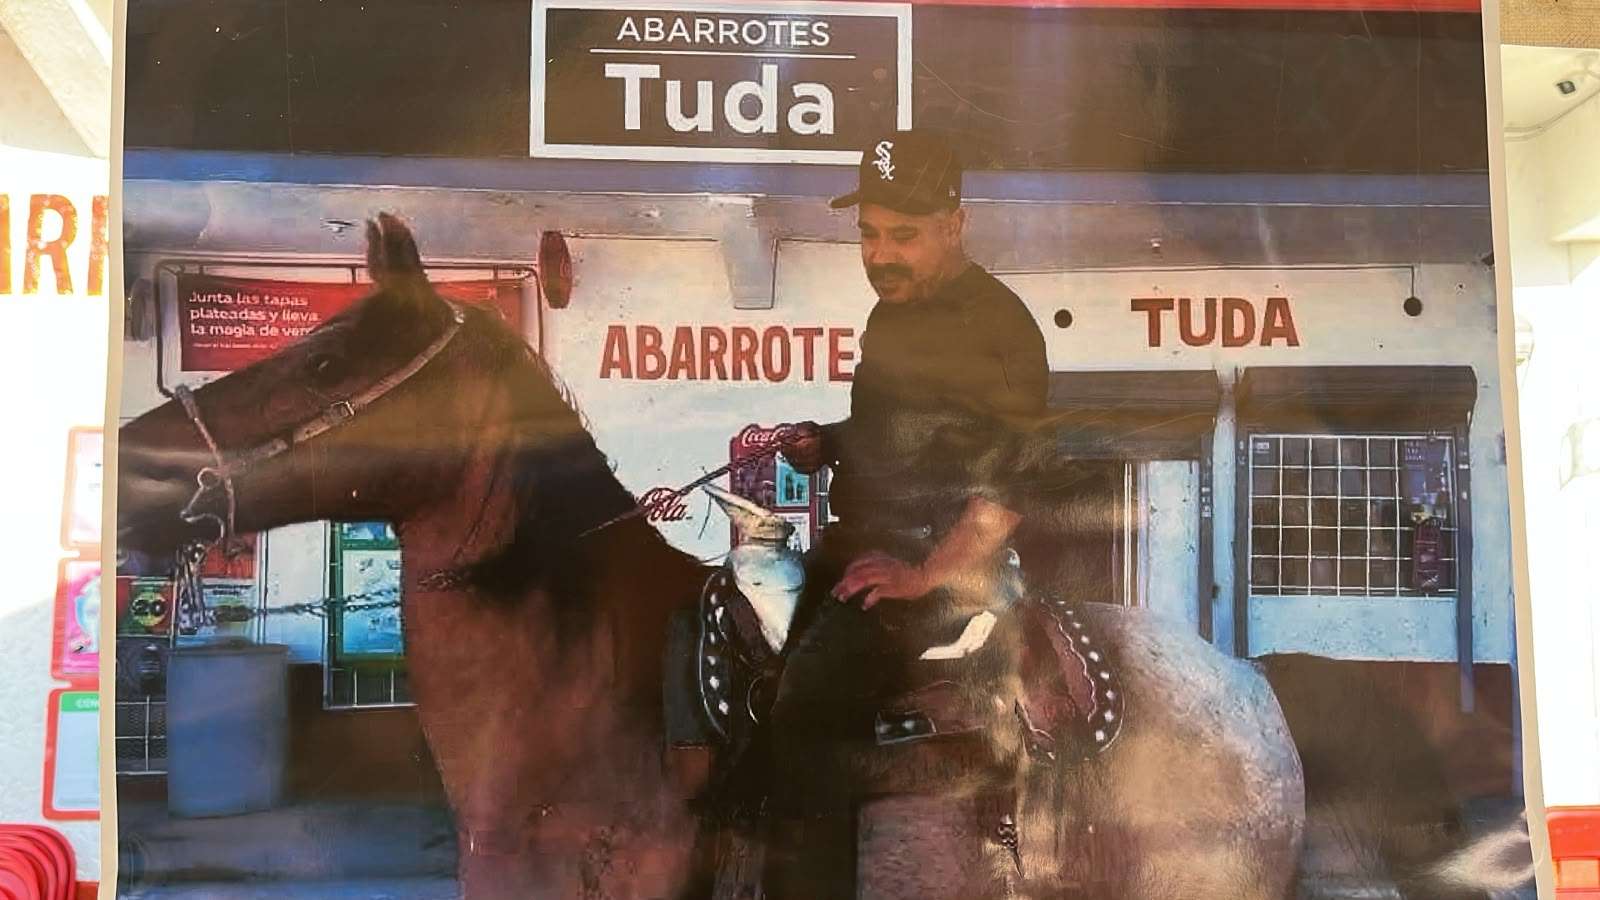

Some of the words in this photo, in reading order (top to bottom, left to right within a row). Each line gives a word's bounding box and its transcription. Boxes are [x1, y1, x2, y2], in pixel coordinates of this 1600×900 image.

[617, 17, 830, 47] ABARROTES
[605, 63, 835, 135] Tuda
[188, 291, 233, 304] Junta
[189, 308, 267, 321] plateadas
[268, 311, 279, 322] y
[282, 311, 319, 322] lleva
[1131, 298, 1300, 347] TUDA
[259, 325, 280, 337] de
[600, 325, 855, 382] ABARROTE
